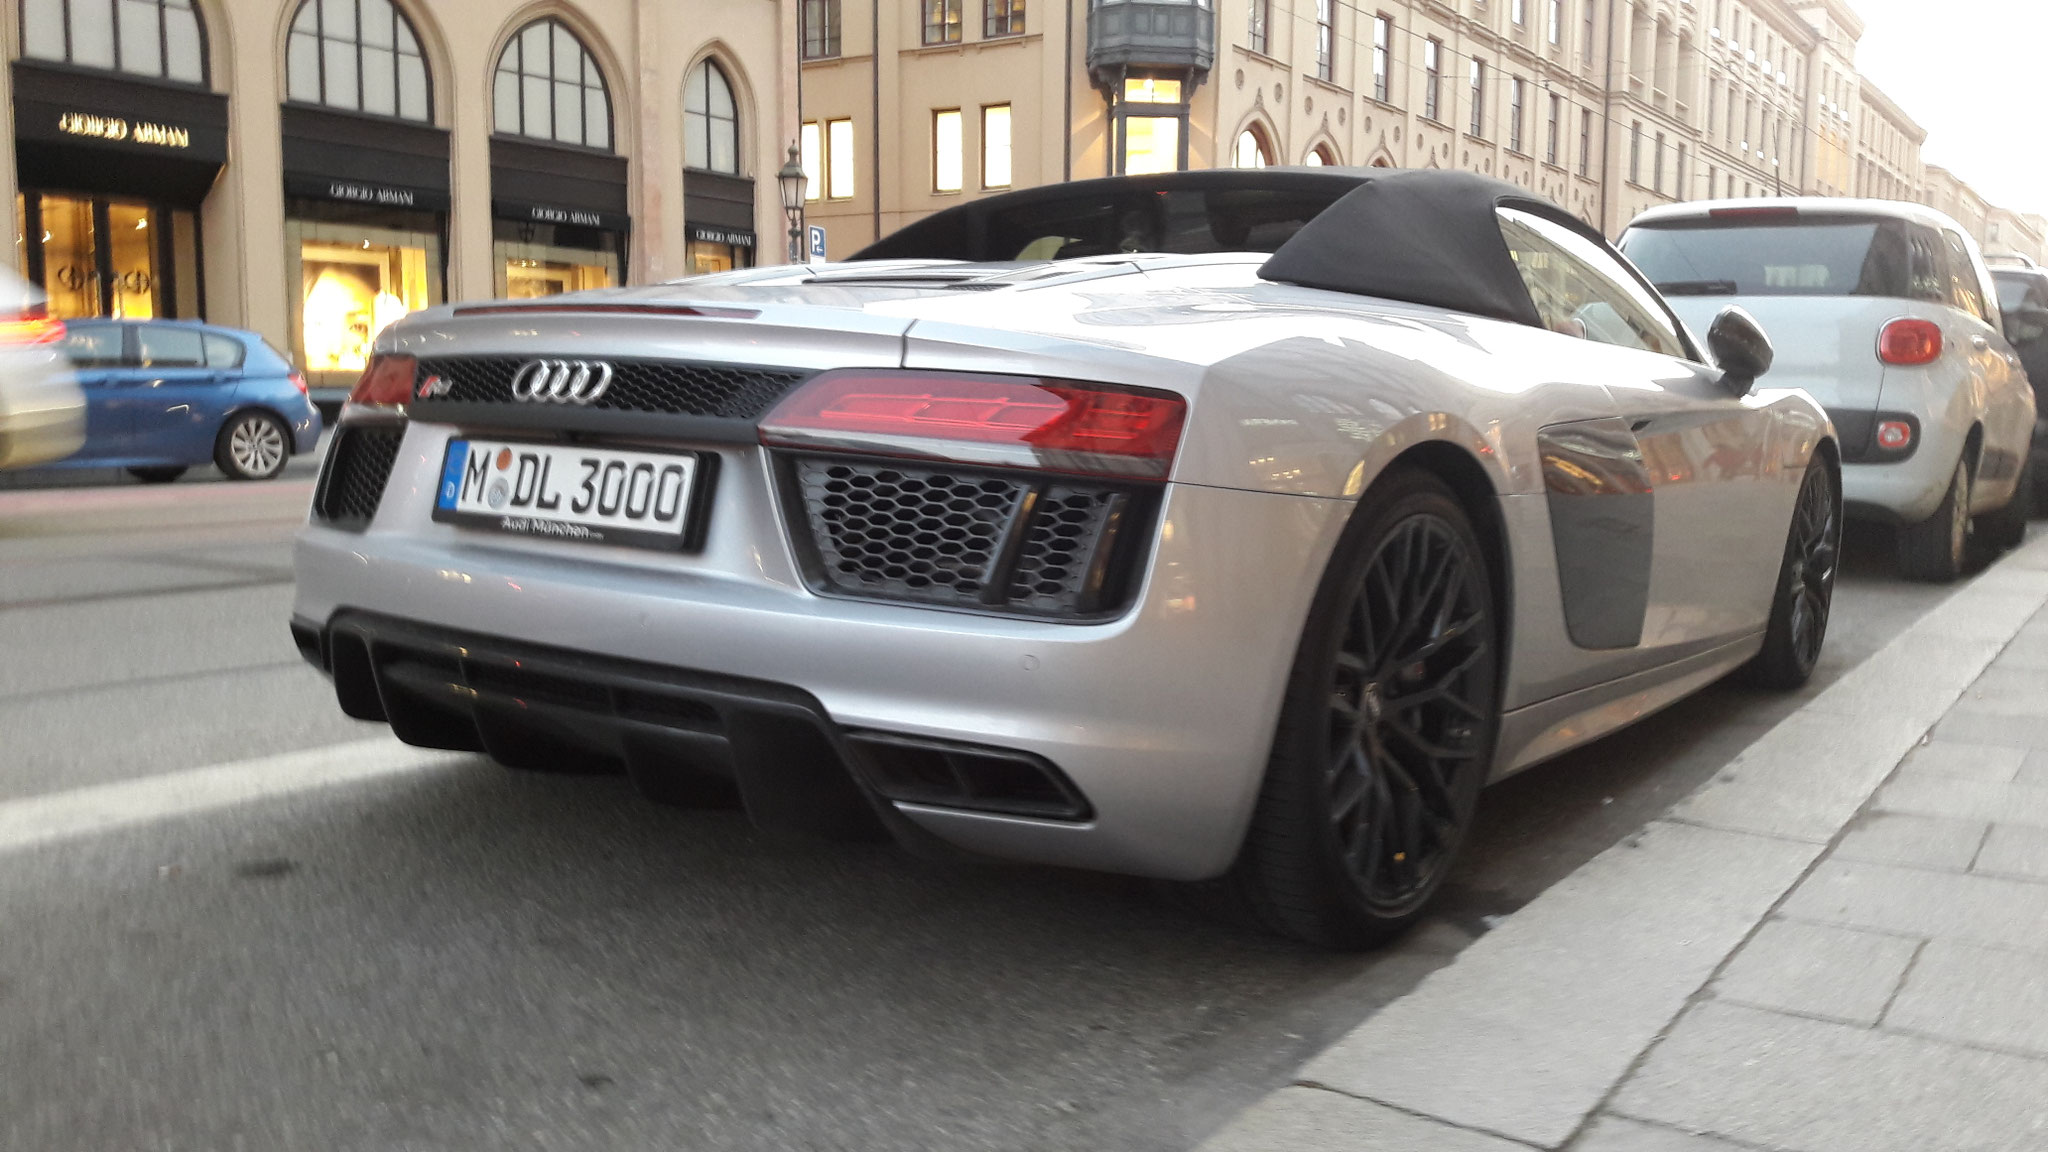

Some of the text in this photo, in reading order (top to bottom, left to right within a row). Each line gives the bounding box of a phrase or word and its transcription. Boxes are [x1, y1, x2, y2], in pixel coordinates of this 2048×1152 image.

[58, 112, 188, 148] GIORGIO ARMANI
[376, 188, 413, 206] ARMANI
[811, 230, 821, 252] P
[446, 480, 455, 499] D
[462, 450, 686, 521] M DL 3000
[502, 515, 531, 532] Audi
